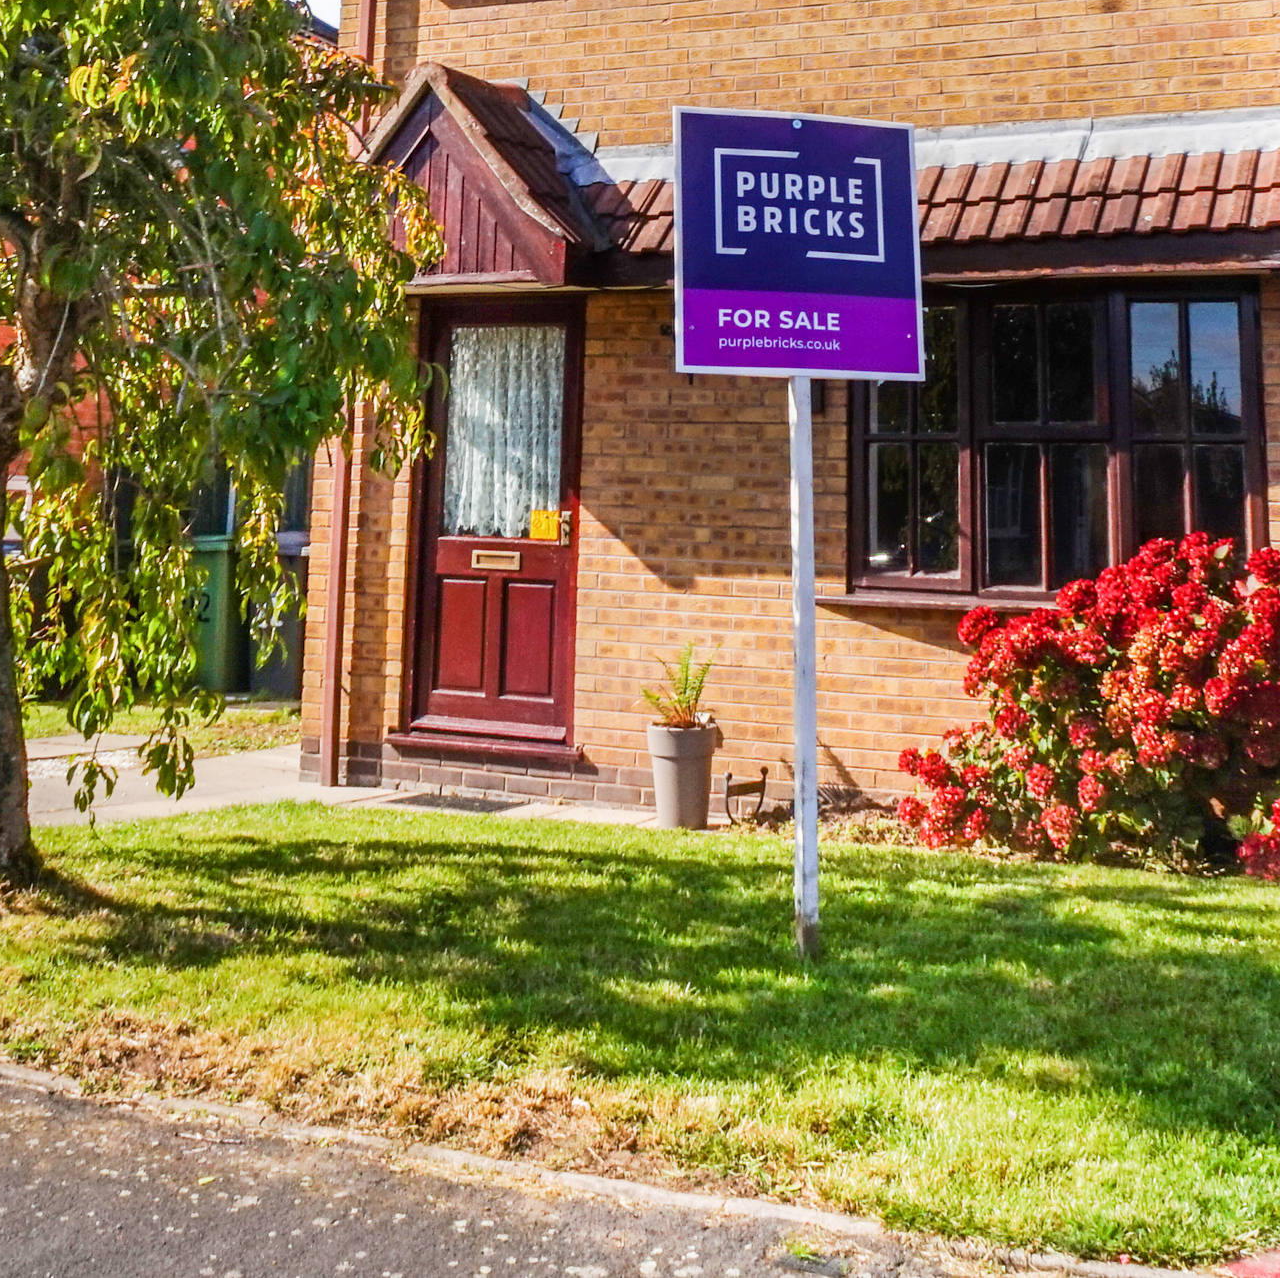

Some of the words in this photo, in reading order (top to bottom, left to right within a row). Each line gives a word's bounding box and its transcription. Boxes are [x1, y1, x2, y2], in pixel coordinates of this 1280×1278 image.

[737, 171, 863, 204] PURPLE
[737, 205, 865, 239] BRICKS
[718, 308, 770, 328] FOR
[779, 310, 840, 331] SALE
[718, 336, 840, 351] purplebricks.co.uk
